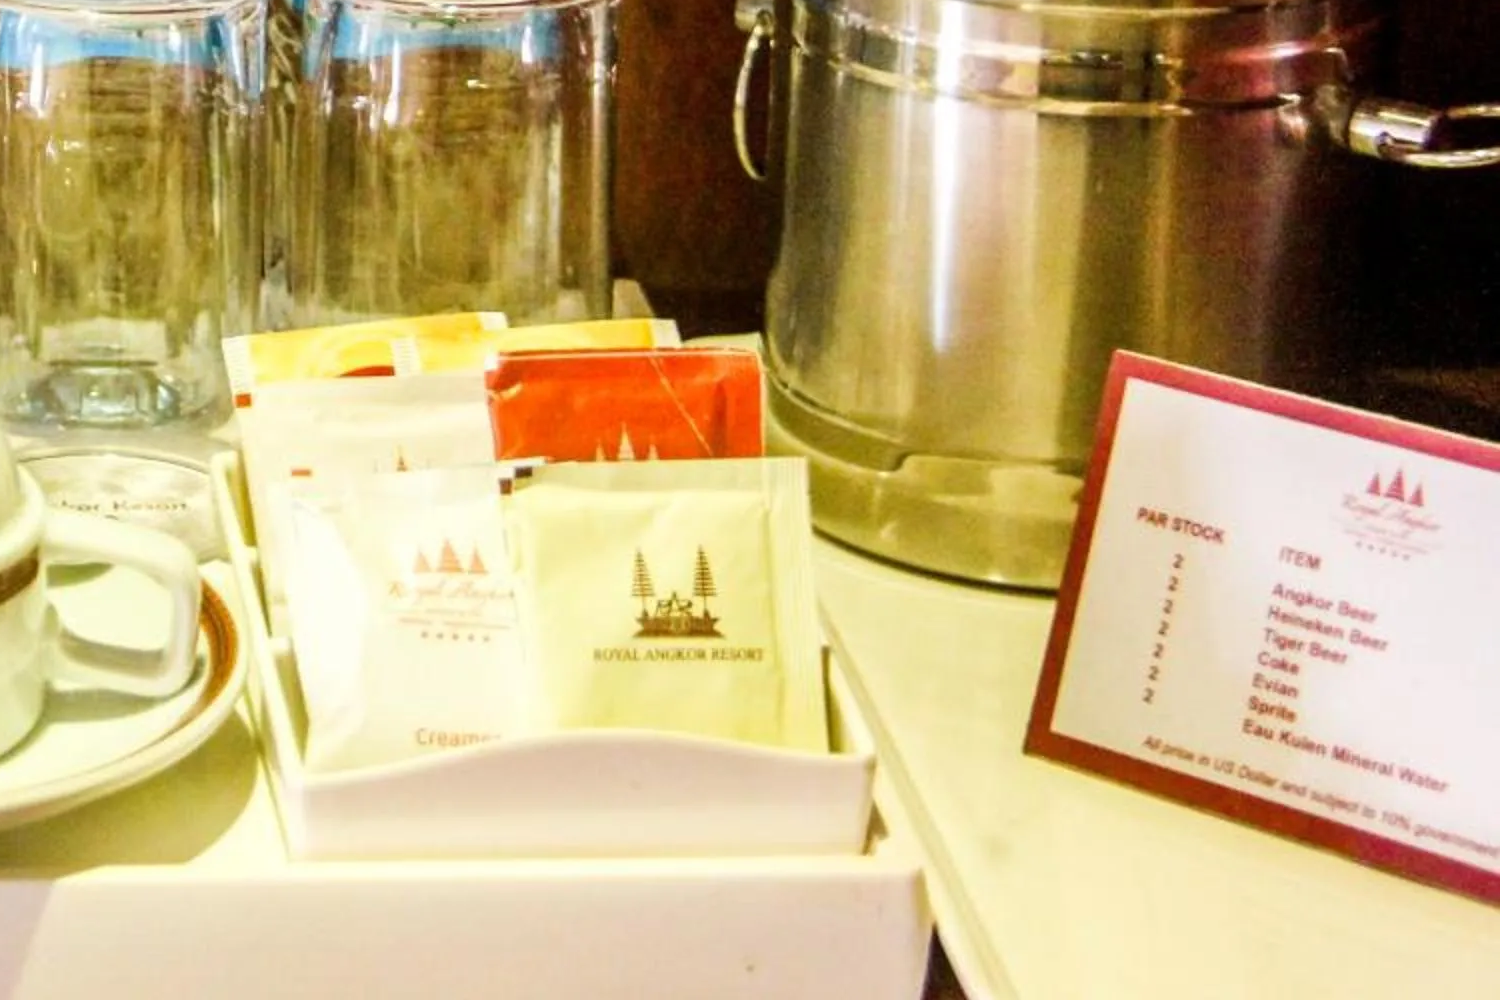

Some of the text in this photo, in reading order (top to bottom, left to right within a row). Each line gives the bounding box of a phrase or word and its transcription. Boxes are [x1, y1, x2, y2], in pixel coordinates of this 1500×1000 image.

[1137, 507, 1225, 543] PAR STOCK
[1173, 553, 1184, 569] 2
[1278, 545, 1322, 571] ITEM
[1168, 576, 1179, 591] 2
[1163, 599, 1174, 614] 2
[1271, 583, 1378, 624] Angkor Beer
[1158, 620, 1169, 636] 2
[1267, 605, 1389, 652] Heineken Beer
[593, 648, 764, 662] ROYAL ANGKOR RESORT
[1153, 643, 1164, 659] 2
[1264, 627, 1349, 665] Tiger Beer
[1148, 665, 1160, 681] 2
[1257, 651, 1300, 676] Coke
[1142, 688, 1155, 704] 2
[1251, 672, 1299, 699] Evian
[1247, 695, 1297, 724] Sprite
[1242, 718, 1449, 793] Eau Kulen Mineral Water
[1142, 734, 1162, 750] All
[1161, 744, 1195, 763] price
[1213, 760, 1235, 775] US
[1237, 765, 1279, 787] Dollar
[1280, 780, 1308, 797] and
[1310, 791, 1359, 813] subject
[1361, 805, 1377, 819] to
[1382, 810, 1412, 831] 10%
